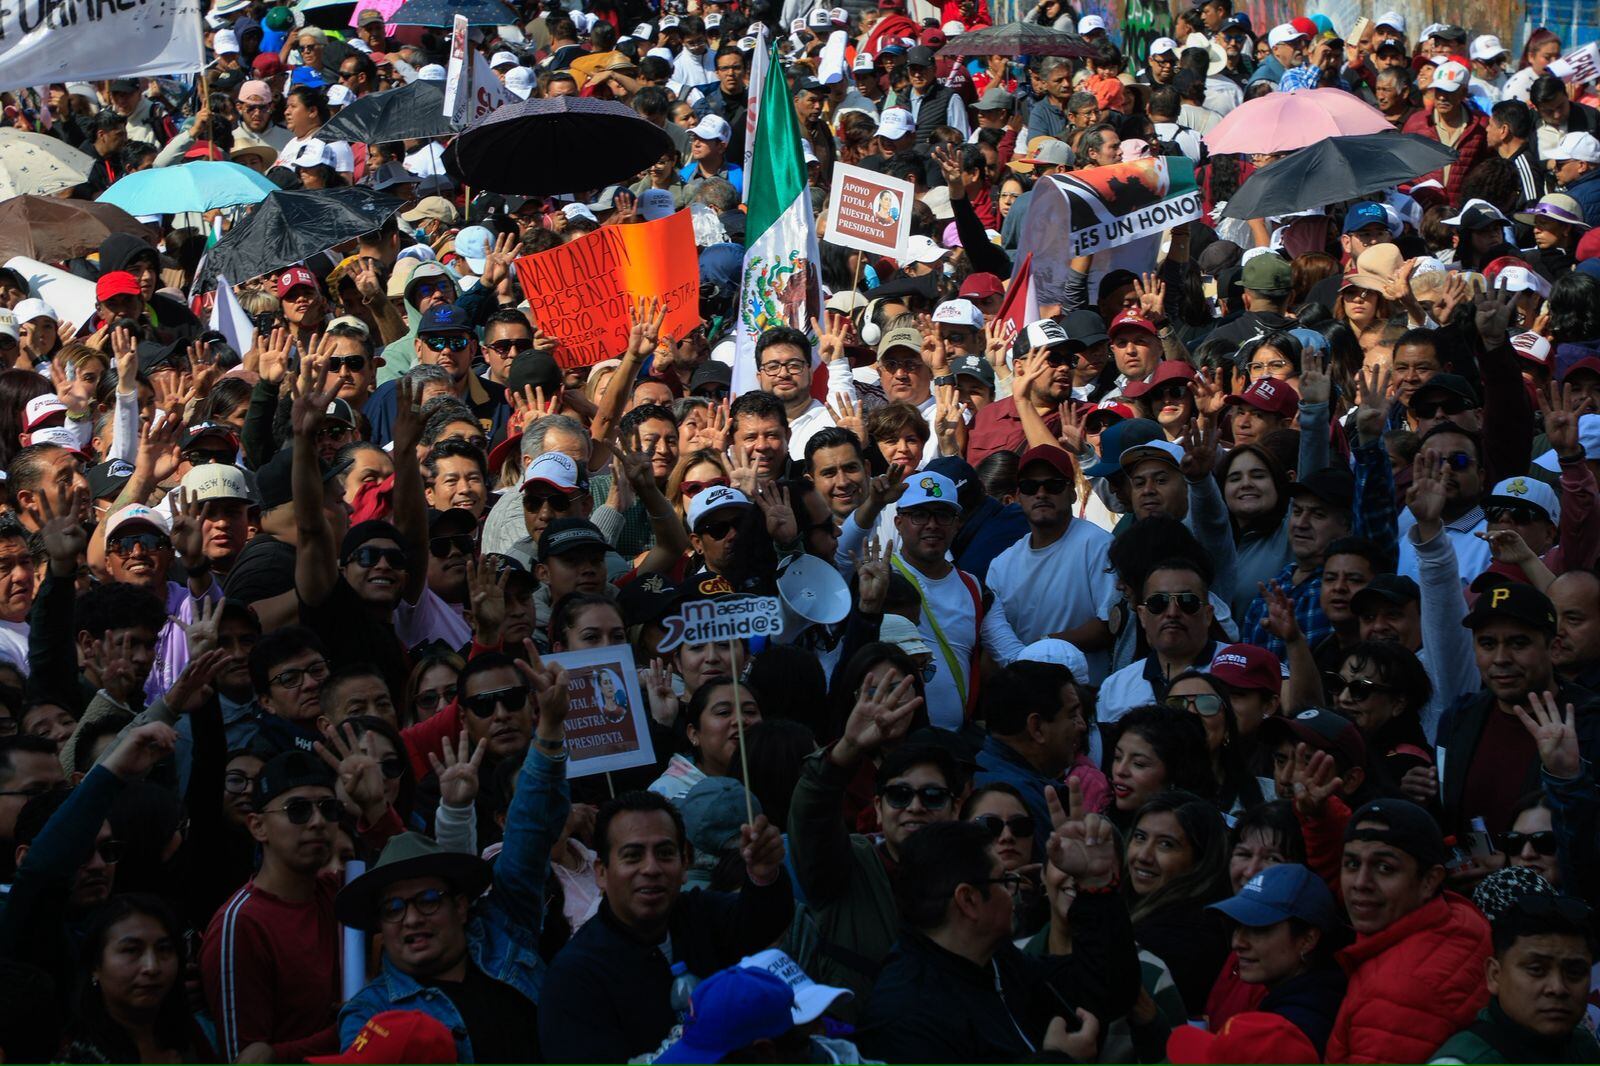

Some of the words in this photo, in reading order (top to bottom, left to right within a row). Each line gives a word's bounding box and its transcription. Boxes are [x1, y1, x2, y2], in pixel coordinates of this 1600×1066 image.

[843, 183, 870, 196] APOYO
[842, 194, 866, 208] TOTAL
[867, 202, 873, 210] A
[840, 206, 875, 223] NUESTRA
[838, 218, 885, 238] PRESIDENTA
[1074, 228, 1100, 256] ¡ES
[1105, 218, 1133, 241] UN
[516, 226, 632, 298] NAUCALPAN
[528, 269, 626, 321] PRESENTE
[540, 311, 593, 338] APOYO
[561, 327, 608, 347] ESIDENTA
[557, 341, 610, 370] LAUDIA
[199, 478, 218, 493] NEW
[222, 478, 241, 492] YORK
[711, 489, 727, 497] NIKE
[1492, 588, 1511, 609] P
[1216, 653, 1247, 665] morena
[563, 713, 607, 732] NUESTRA
[568, 731, 625, 751] PRESIDENTA
